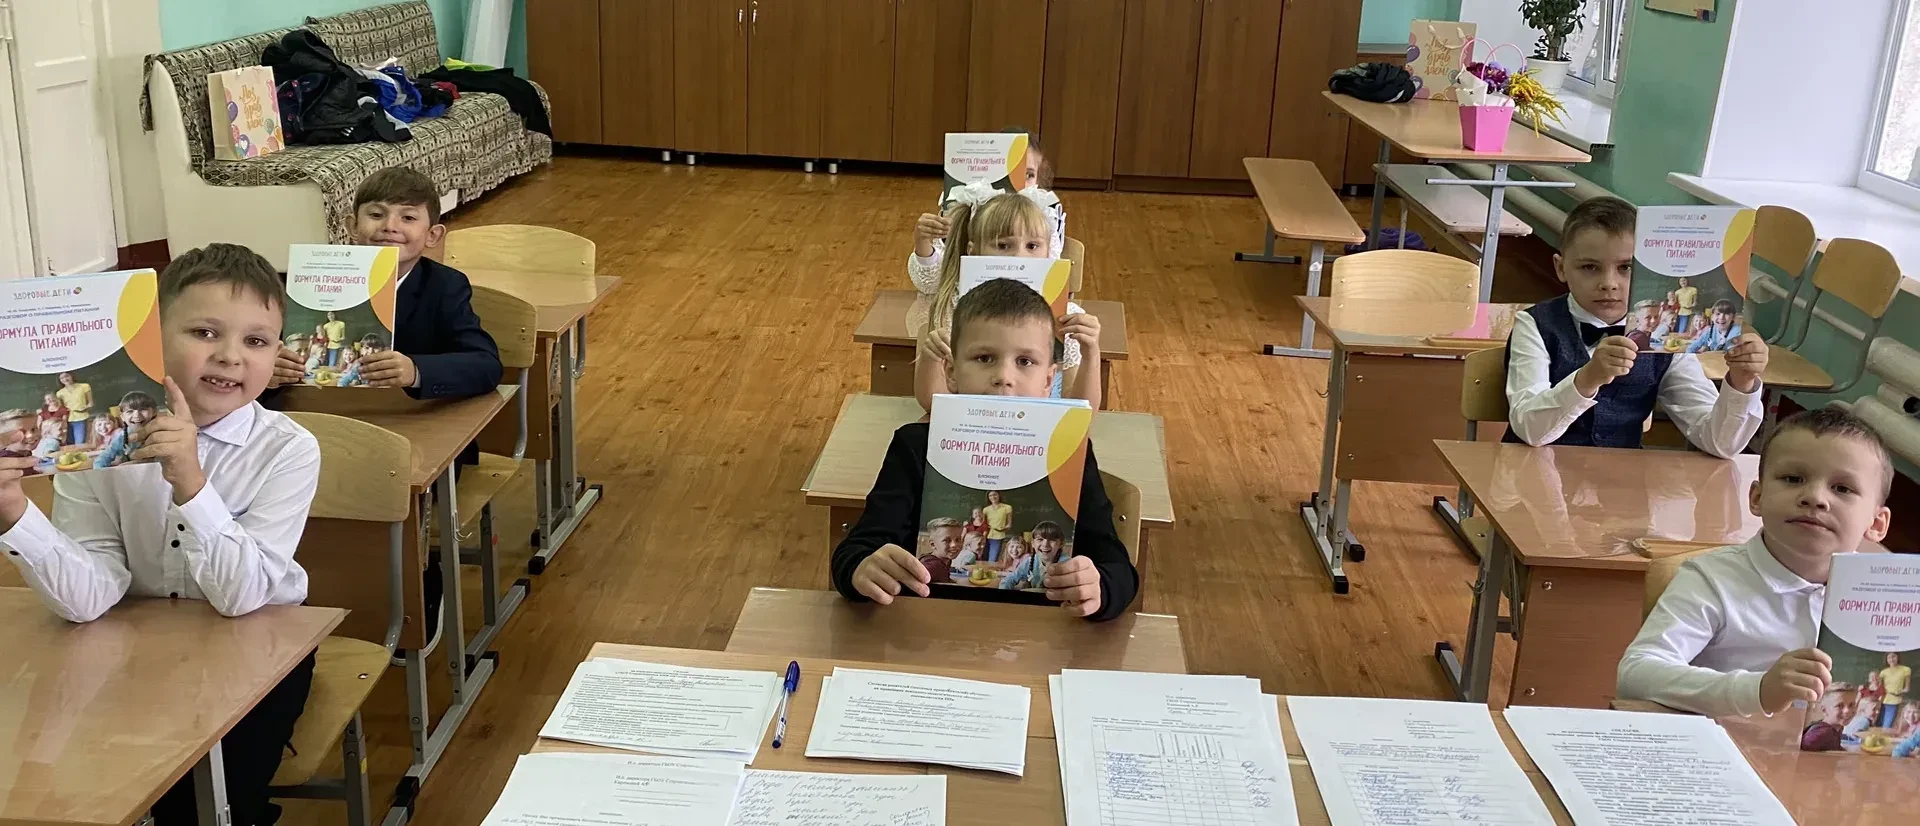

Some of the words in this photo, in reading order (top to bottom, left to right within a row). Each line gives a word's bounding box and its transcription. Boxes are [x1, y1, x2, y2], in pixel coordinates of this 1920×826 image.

[1643, 239, 1672, 248] ФОРМУЛА
[1675, 239, 1720, 249] ПРАВИЛЬНОГО
[1666, 249, 1695, 258] ПИТАНИЯ
[294, 274, 320, 284] ФОРМУЛА
[322, 275, 366, 285] ПРАВИЛЬНОГО
[13, 289, 50, 301] ЗДОРОВЫЕ
[52, 288, 71, 297] ДЕТИ
[314, 284, 342, 293] ПИТАНИЯ
[41, 318, 113, 336] ПРАВИЛЬНОГО
[30, 335, 77, 350] ПИТАНИЯ
[967, 408, 998, 418] ЗДОРОВЫЕ
[999, 411, 1016, 419] ДЕТИ
[940, 438, 980, 451] ФОРМУЛА
[983, 442, 1044, 456] ПРАВИЛЬНОГО
[970, 454, 1010, 467] ПИТАНИЯ
[1838, 599, 1880, 612] ФОРМУЛА
[1870, 614, 1912, 627] ПИТАНИЯ
